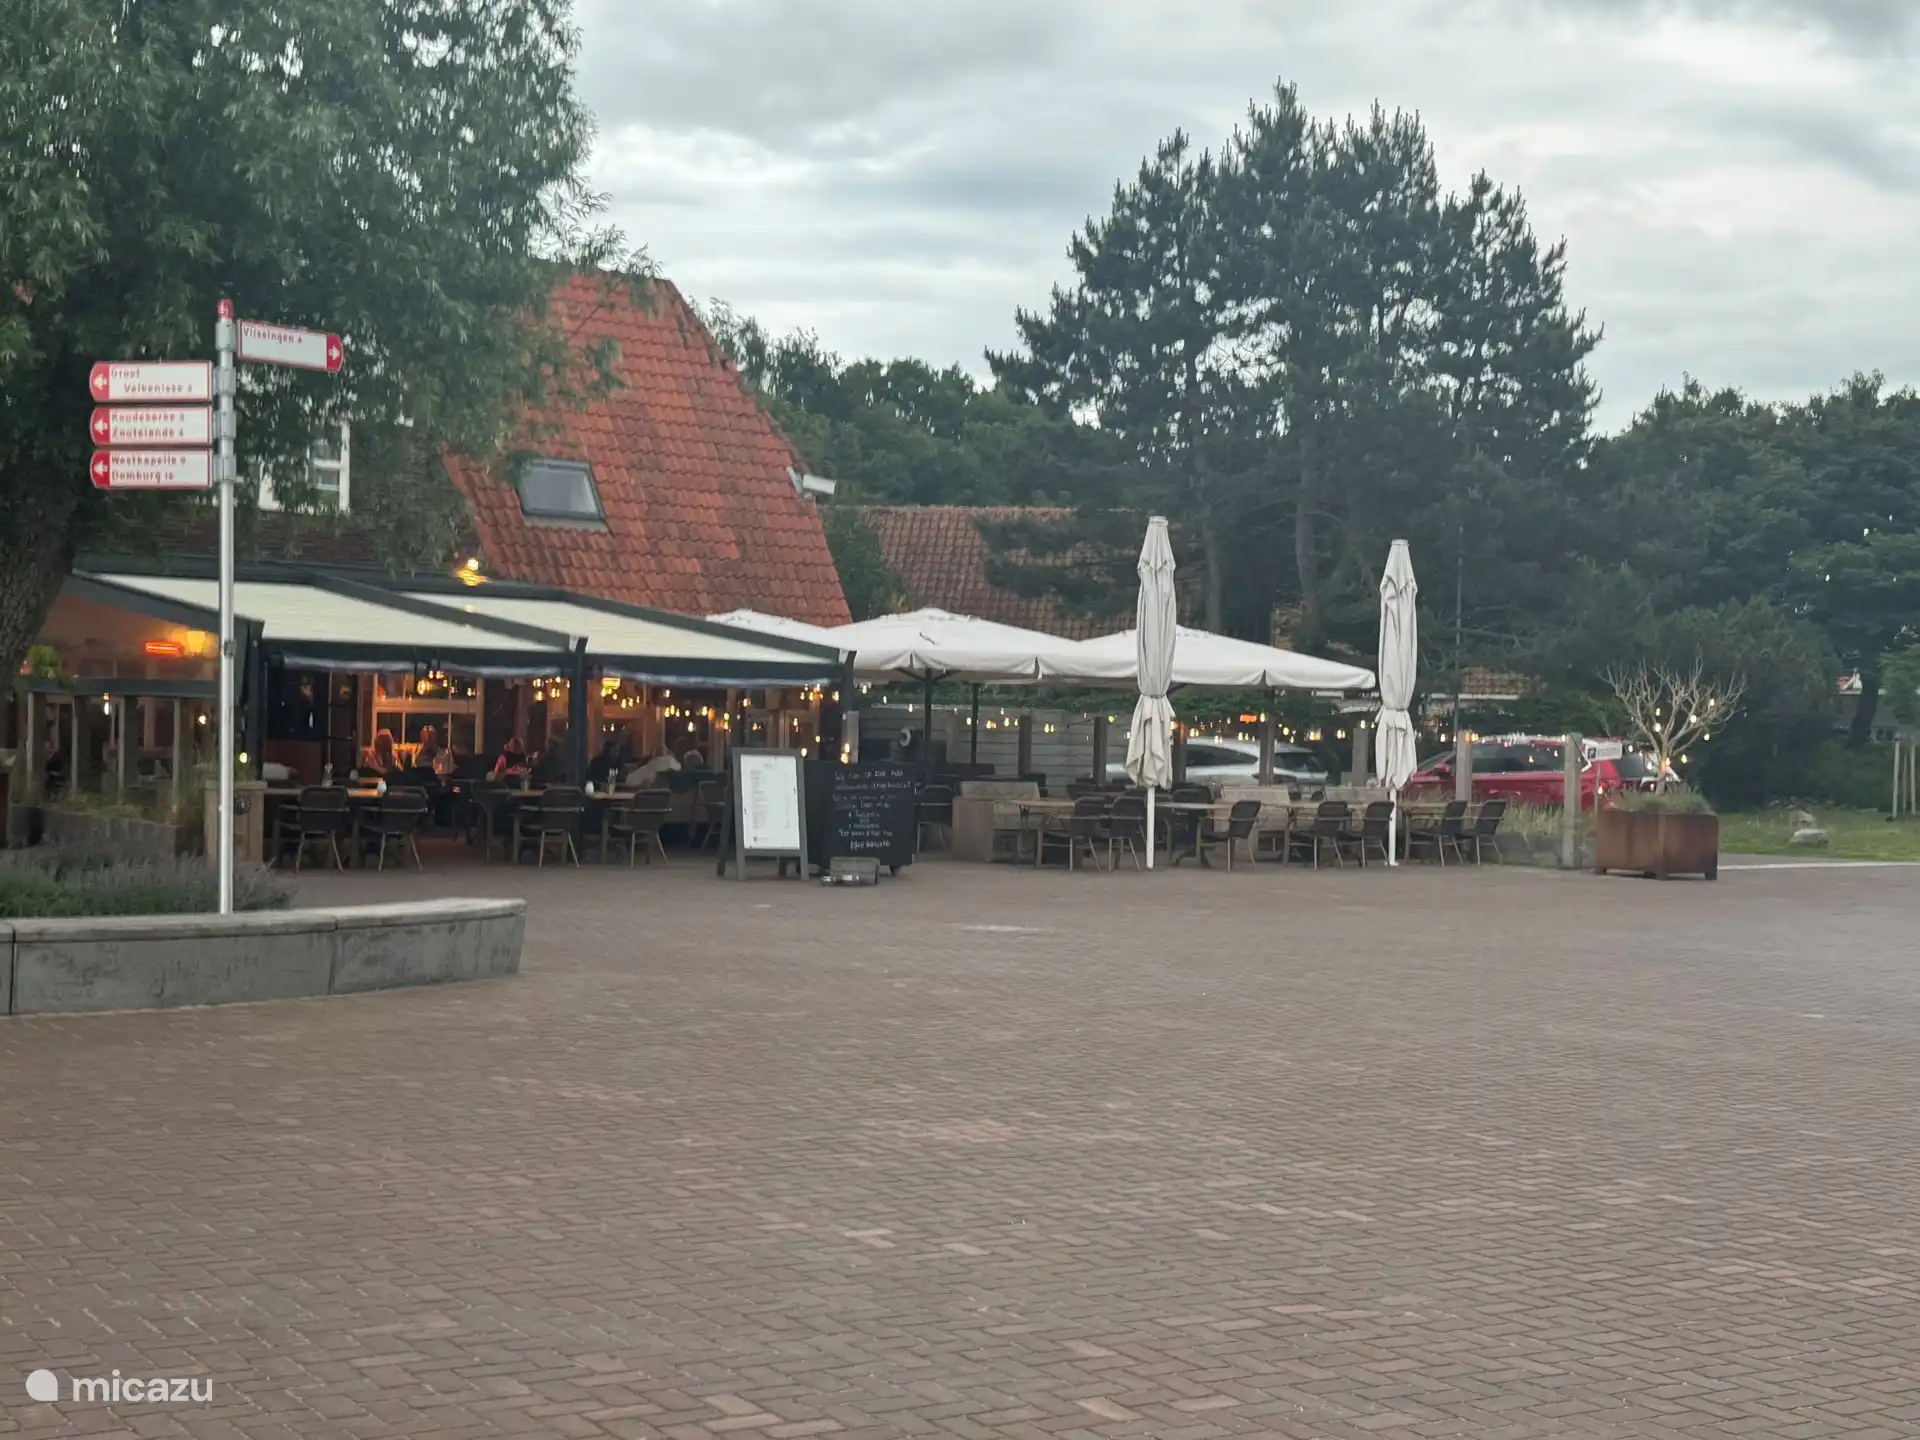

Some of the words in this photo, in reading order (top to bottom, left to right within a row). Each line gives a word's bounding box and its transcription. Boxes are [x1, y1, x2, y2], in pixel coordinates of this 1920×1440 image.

[243, 324, 295, 345] Vlissingen
[111, 454, 177, 467] Westkapelle
[111, 470, 161, 485] Domburg
